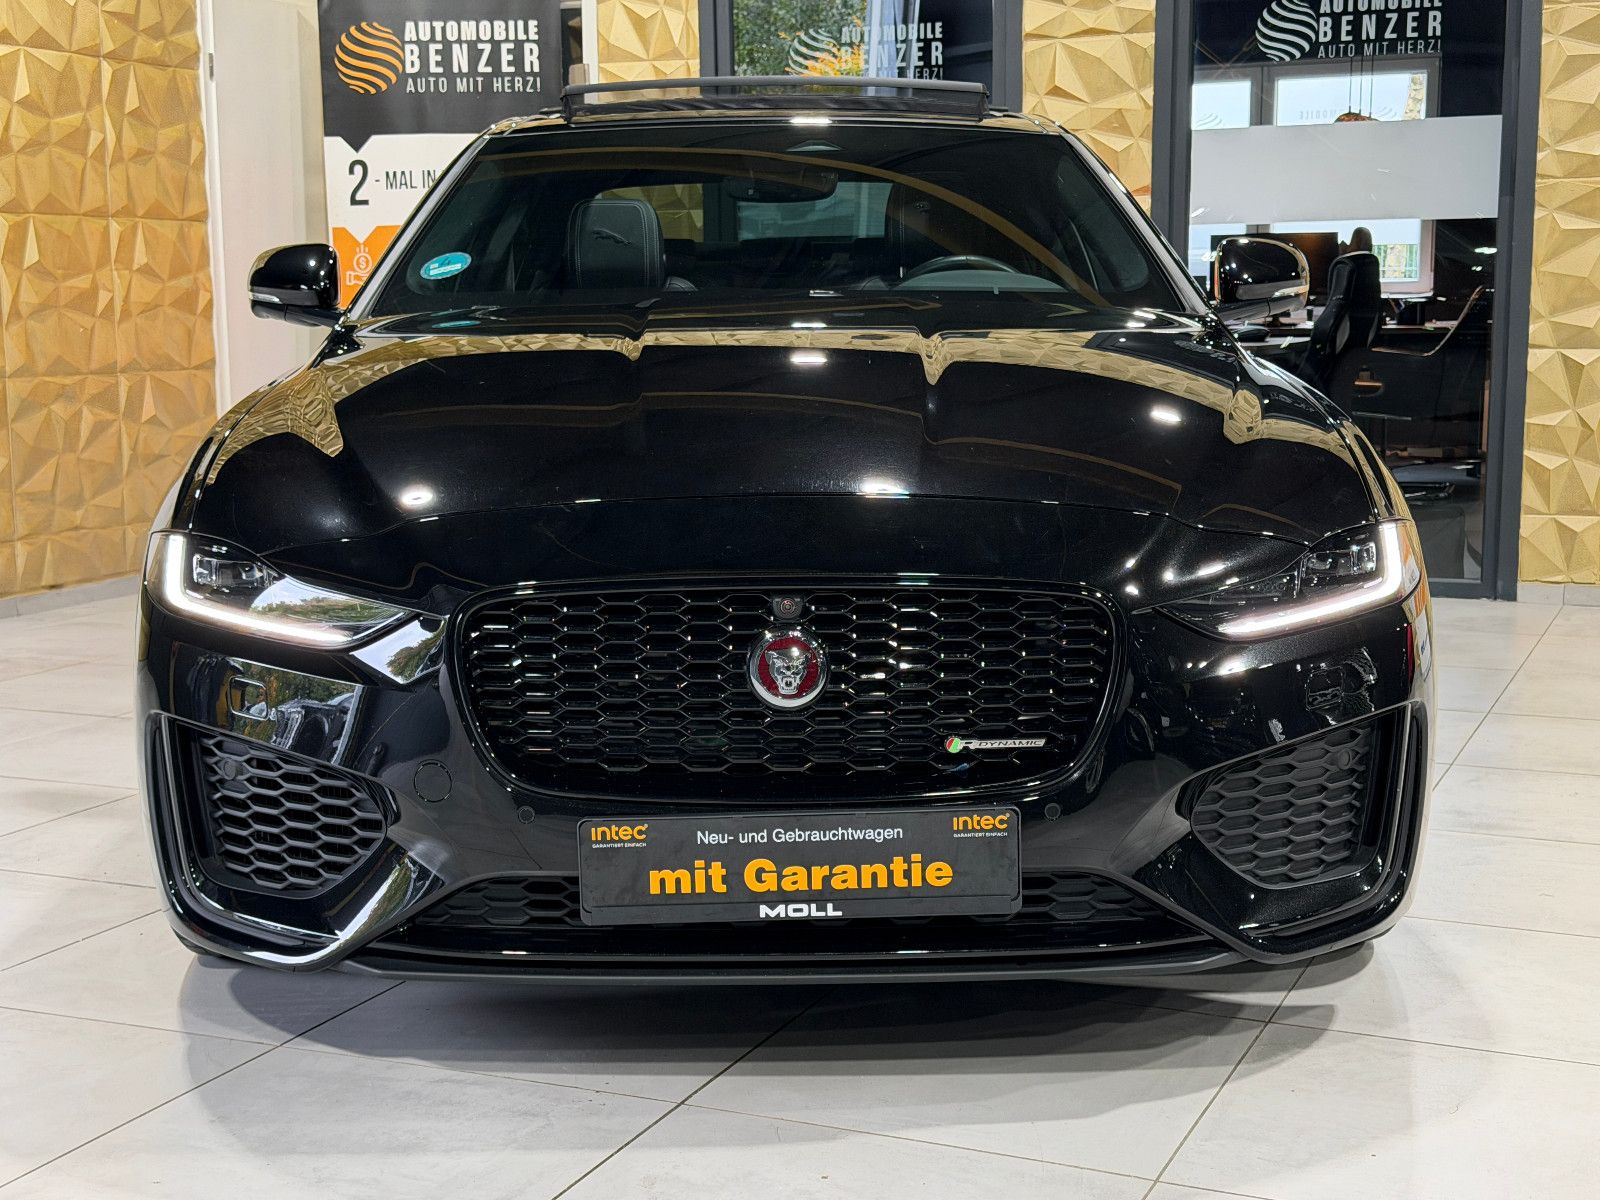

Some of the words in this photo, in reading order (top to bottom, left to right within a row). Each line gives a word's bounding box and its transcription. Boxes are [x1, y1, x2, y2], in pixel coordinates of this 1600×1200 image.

[404, 20, 539, 42] AUTOMOBILE
[841, 21, 943, 44] AUTMOBILE
[1318, 10, 1442, 43] BENZER
[404, 42, 540, 74] BENZER
[1318, 44, 1356, 59] AUTO
[1363, 41, 1389, 57] MIT
[1397, 39, 1441, 54] HERZ!
[406, 77, 448, 94] AUTO
[456, 76, 484, 93] MIT
[493, 76, 541, 93] HERZ!
[348, 159, 370, 206] 2
[385, 170, 417, 190] MAL
[422, 169, 436, 188] IN
[978, 739, 1043, 747] DYNAMIC
[953, 813, 1009, 831] intec
[591, 824, 648, 841] intec
[697, 829, 734, 845] Neu-
[739, 828, 768, 844] und
[772, 825, 904, 845] Gebrauchtwagen
[649, 859, 727, 895] mit
[744, 854, 953, 892] Garantie
[759, 903, 843, 919] MOLL
